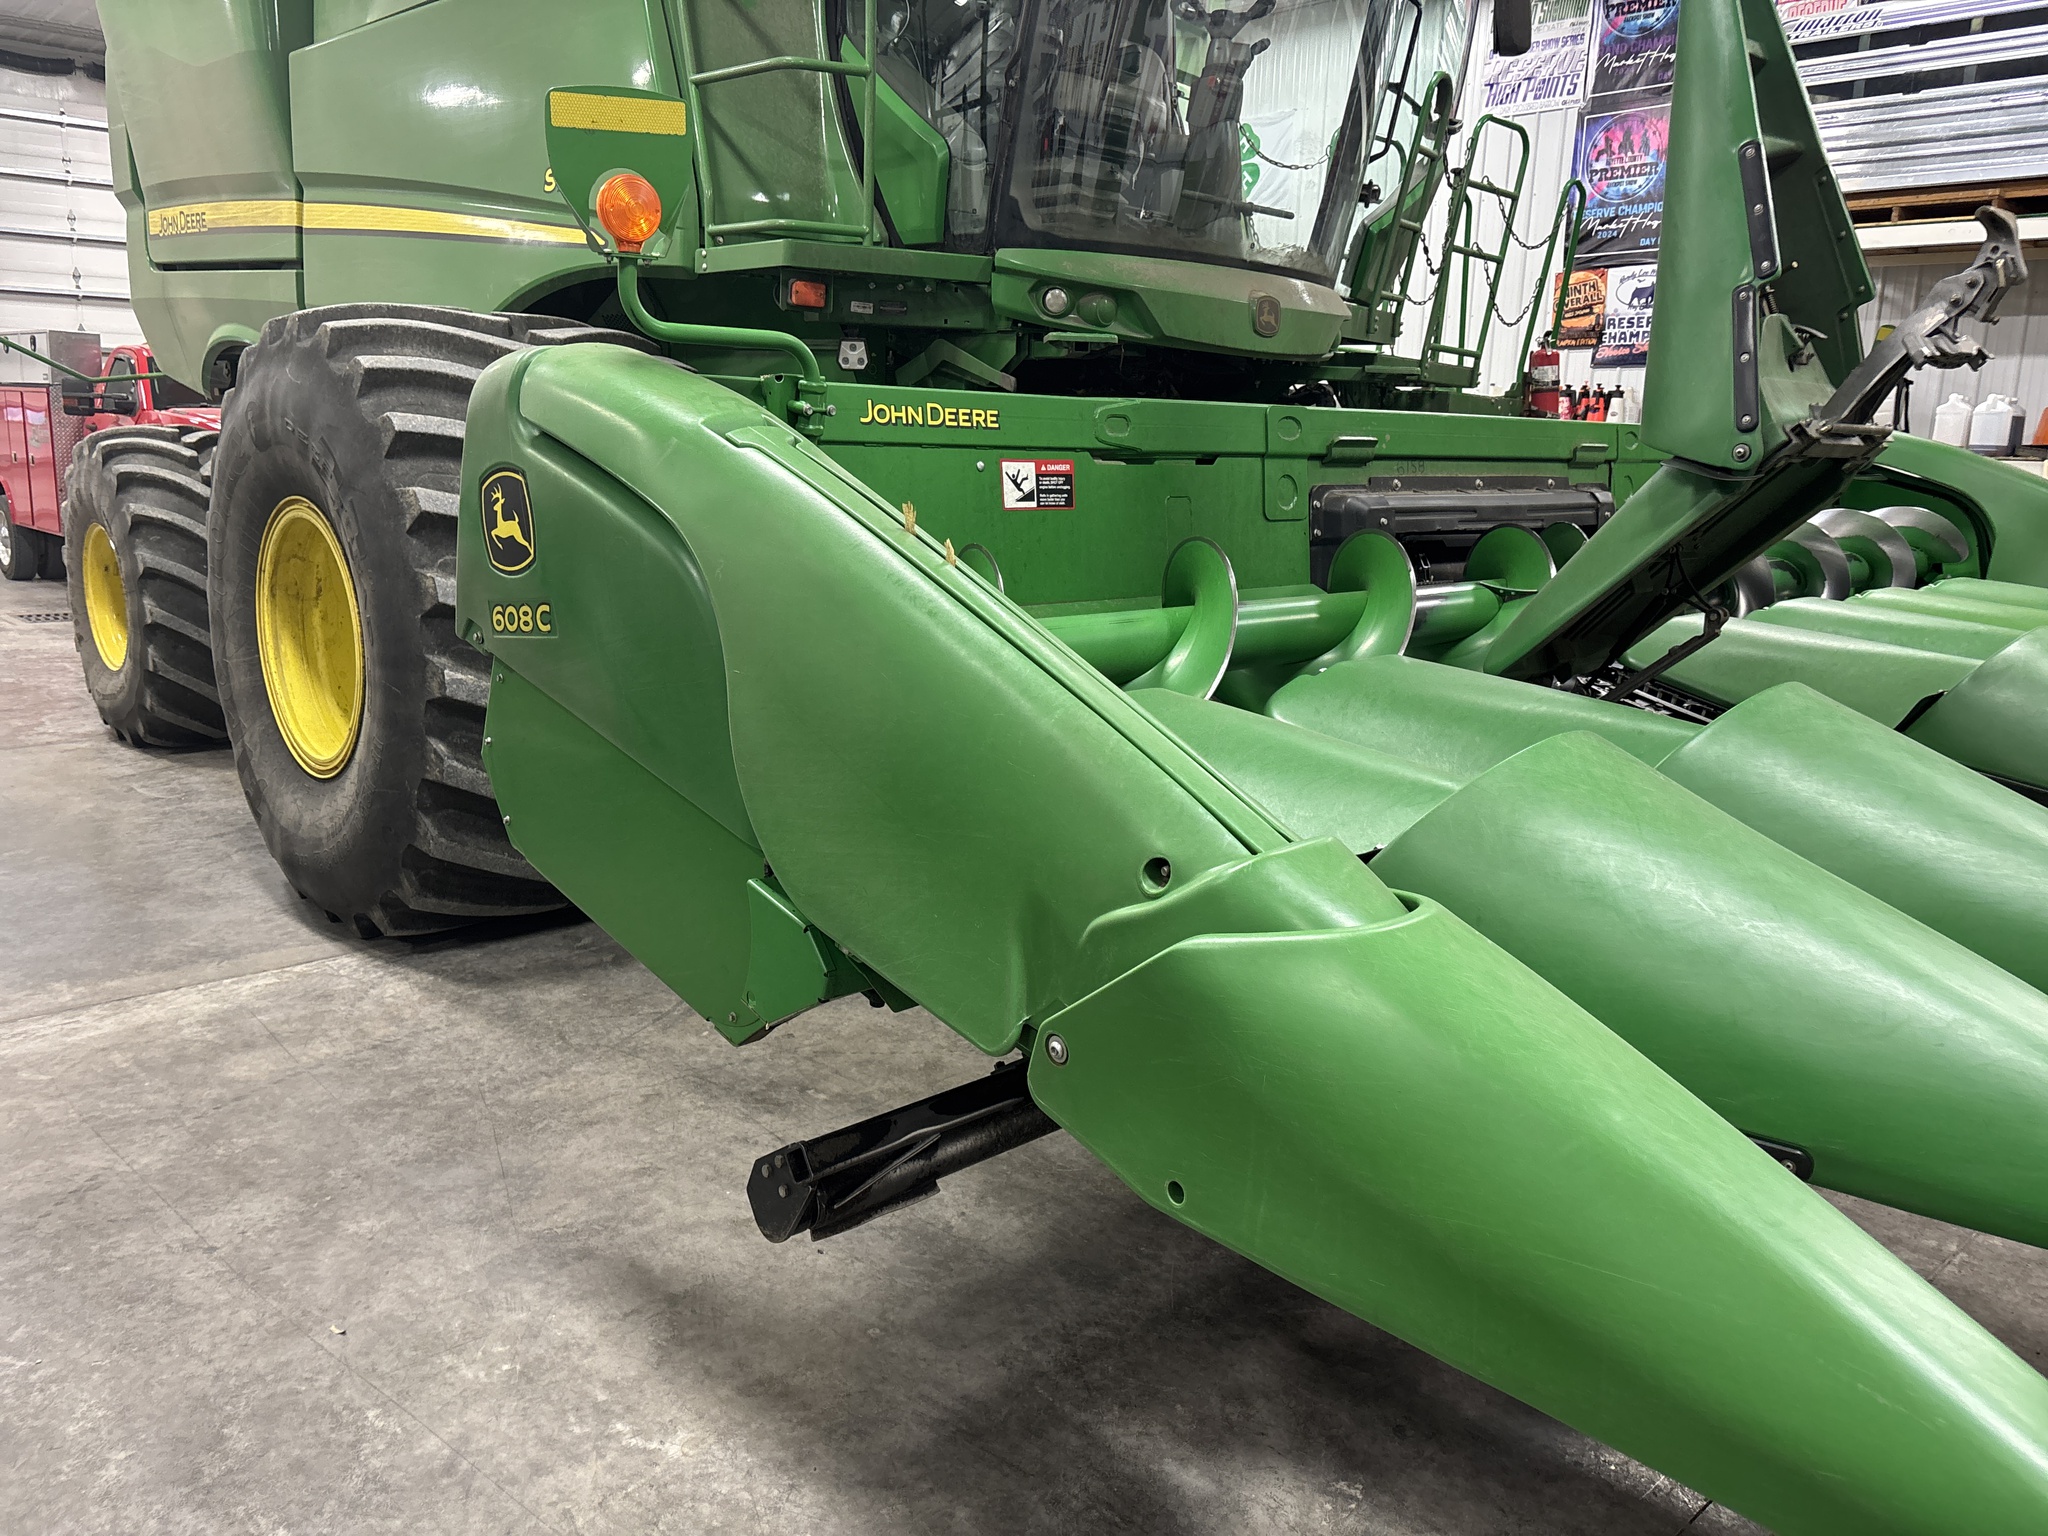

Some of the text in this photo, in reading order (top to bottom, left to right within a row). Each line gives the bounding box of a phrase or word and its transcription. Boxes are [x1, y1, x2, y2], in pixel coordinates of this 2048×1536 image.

[1787, 22, 1877, 40] TRAILERS
[1599, 34, 1675, 56] RAND CHAMPI
[1595, 49, 1654, 74] Market
[1522, 73, 1580, 102] POINTS
[1588, 162, 1658, 183] PREMIER
[1573, 201, 1663, 220] ESERVE CHAMPIO
[159, 211, 207, 235] JOHN DEERE
[1579, 211, 1661, 239] Market Hog
[1596, 230, 1617, 239] 2024
[1639, 237, 1656, 246] DAY
[1556, 292, 1602, 309] VERALL
[1603, 330, 1650, 343] CHAMP
[860, 399, 1000, 429] JOHN DEERE
[491, 603, 552, 633] 608C
